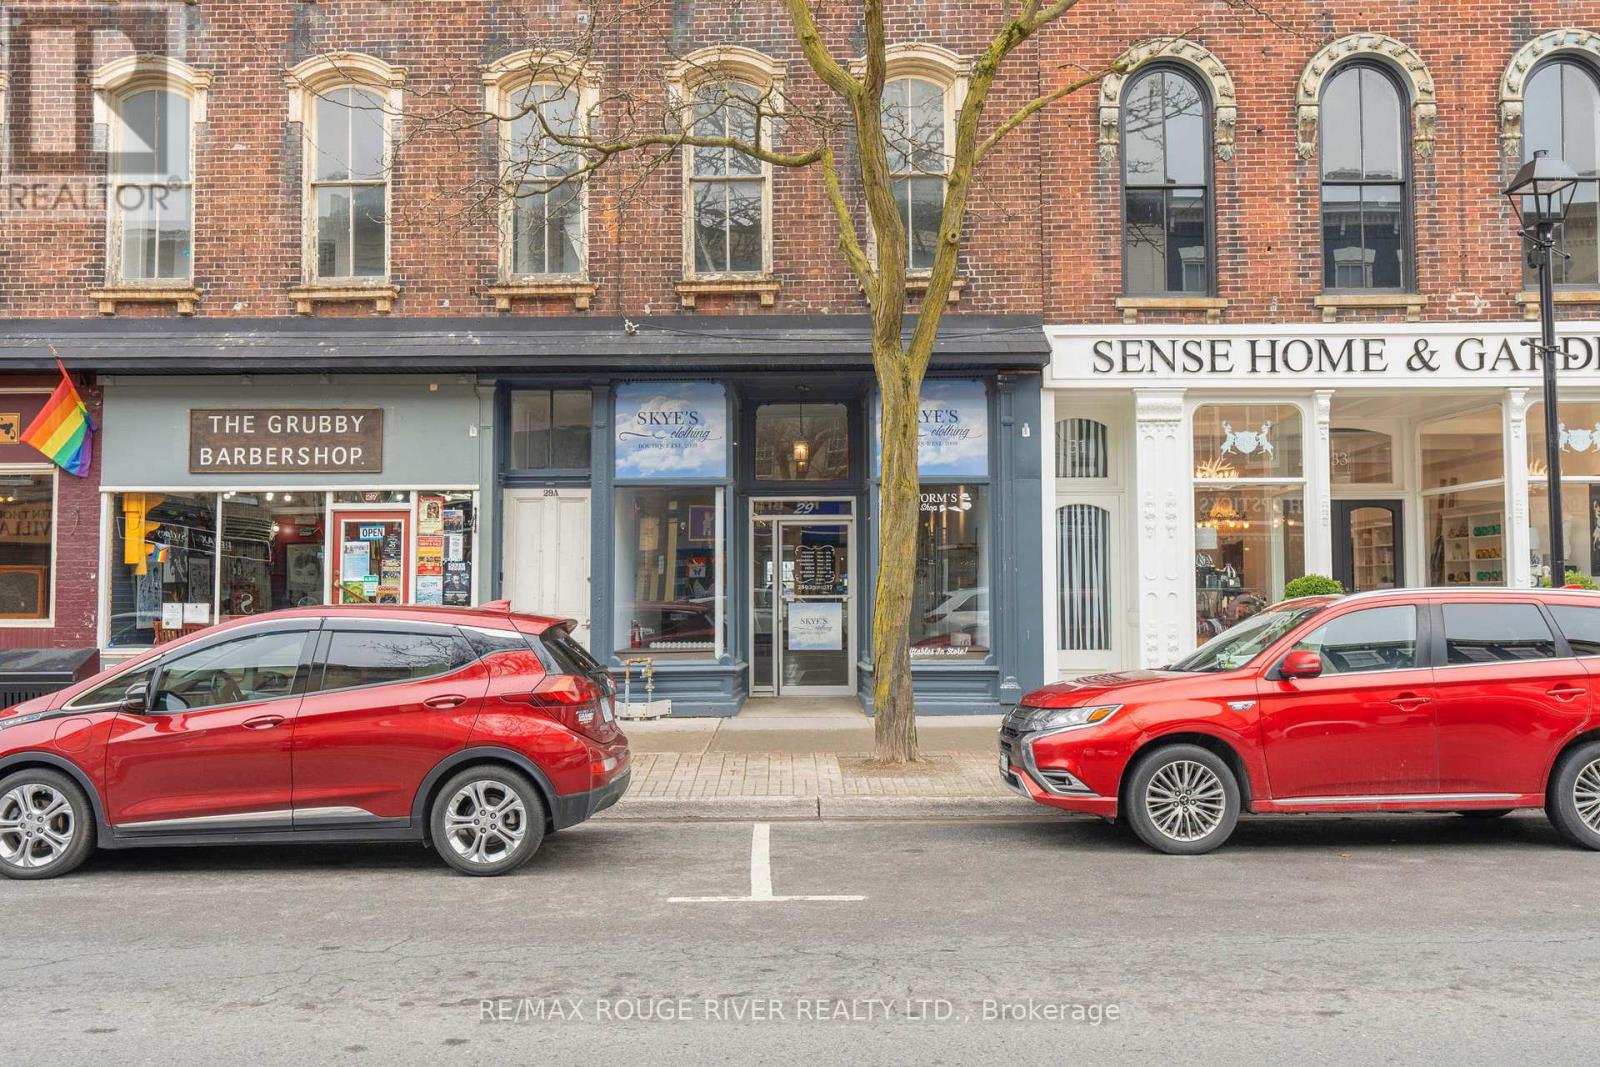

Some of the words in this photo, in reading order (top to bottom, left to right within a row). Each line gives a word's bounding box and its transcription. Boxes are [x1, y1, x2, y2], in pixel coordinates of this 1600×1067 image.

[1093, 339, 1235, 373] SENSE
[1247, 338, 1389, 373] HOME
[1406, 338, 1440, 372] &
[1455, 337, 1600, 372] GAD
[637, 410, 699, 426] SKYE'S
[919, 409, 959, 424] YE'S
[208, 415, 255, 434] THE
[267, 415, 364, 434] GRUBBY
[670, 424, 712, 443] clothing
[931, 424, 971, 441] clothing
[200, 447, 366, 466] BARBERSHOP.
[543, 488, 559, 497] 29A
[919, 493, 957, 503] ORM'S
[793, 502, 814, 515] 29
[361, 527, 384, 538] OPEN
[909, 647, 934, 658] iftables
[946, 647, 969, 656] Store!
